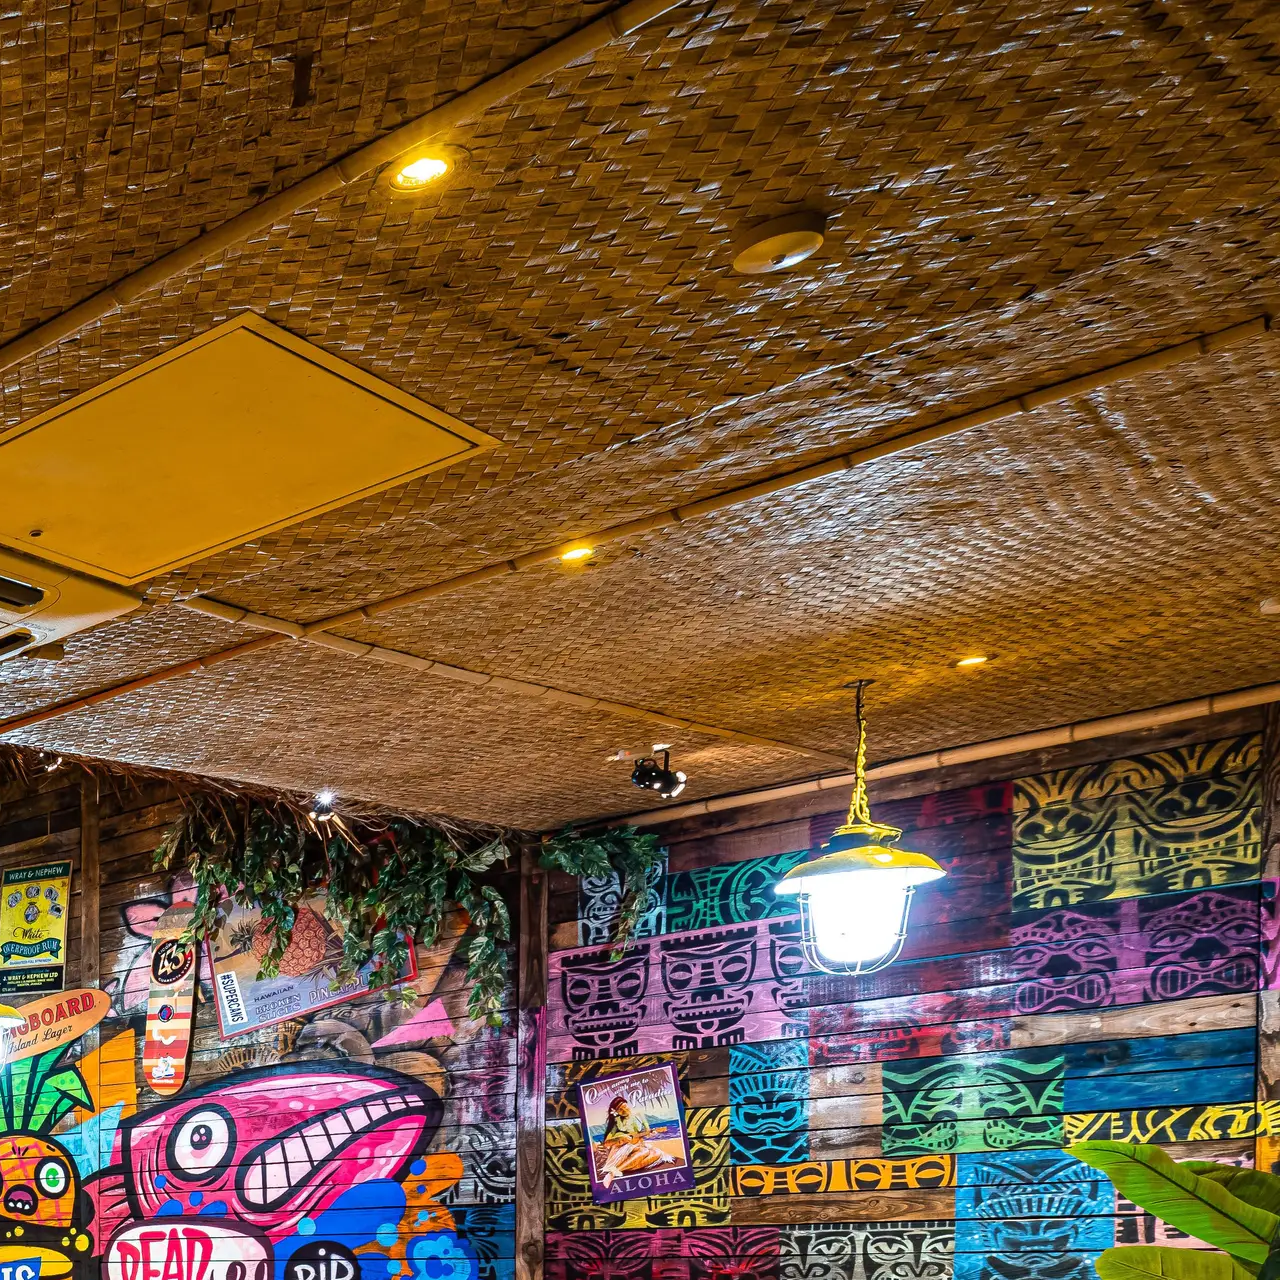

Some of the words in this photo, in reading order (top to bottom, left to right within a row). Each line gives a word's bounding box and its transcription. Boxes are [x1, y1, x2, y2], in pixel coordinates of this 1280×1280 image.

[9, 871, 27, 881] WRAY
[27, 870, 34, 879] &
[35, 866, 64, 877] NEPHEW
[13, 926, 46, 939] White
[2, 940, 41, 956] OVERPROOF
[41, 938, 58, 951] RUM
[157, 943, 185, 976] 43
[220, 973, 244, 1023] #SUPERCANS
[254, 985, 294, 1003] HAWAIIAN
[256, 994, 301, 1014] BROKEN
[258, 1003, 301, 1023] SLICES
[8, 1034, 39, 1054] Island
[42, 1024, 73, 1042] Lager
[611, 1077, 630, 1090] away
[614, 1085, 629, 1095] with
[628, 1089, 672, 1108] Paradise
[609, 1171, 687, 1195] ALOHA
